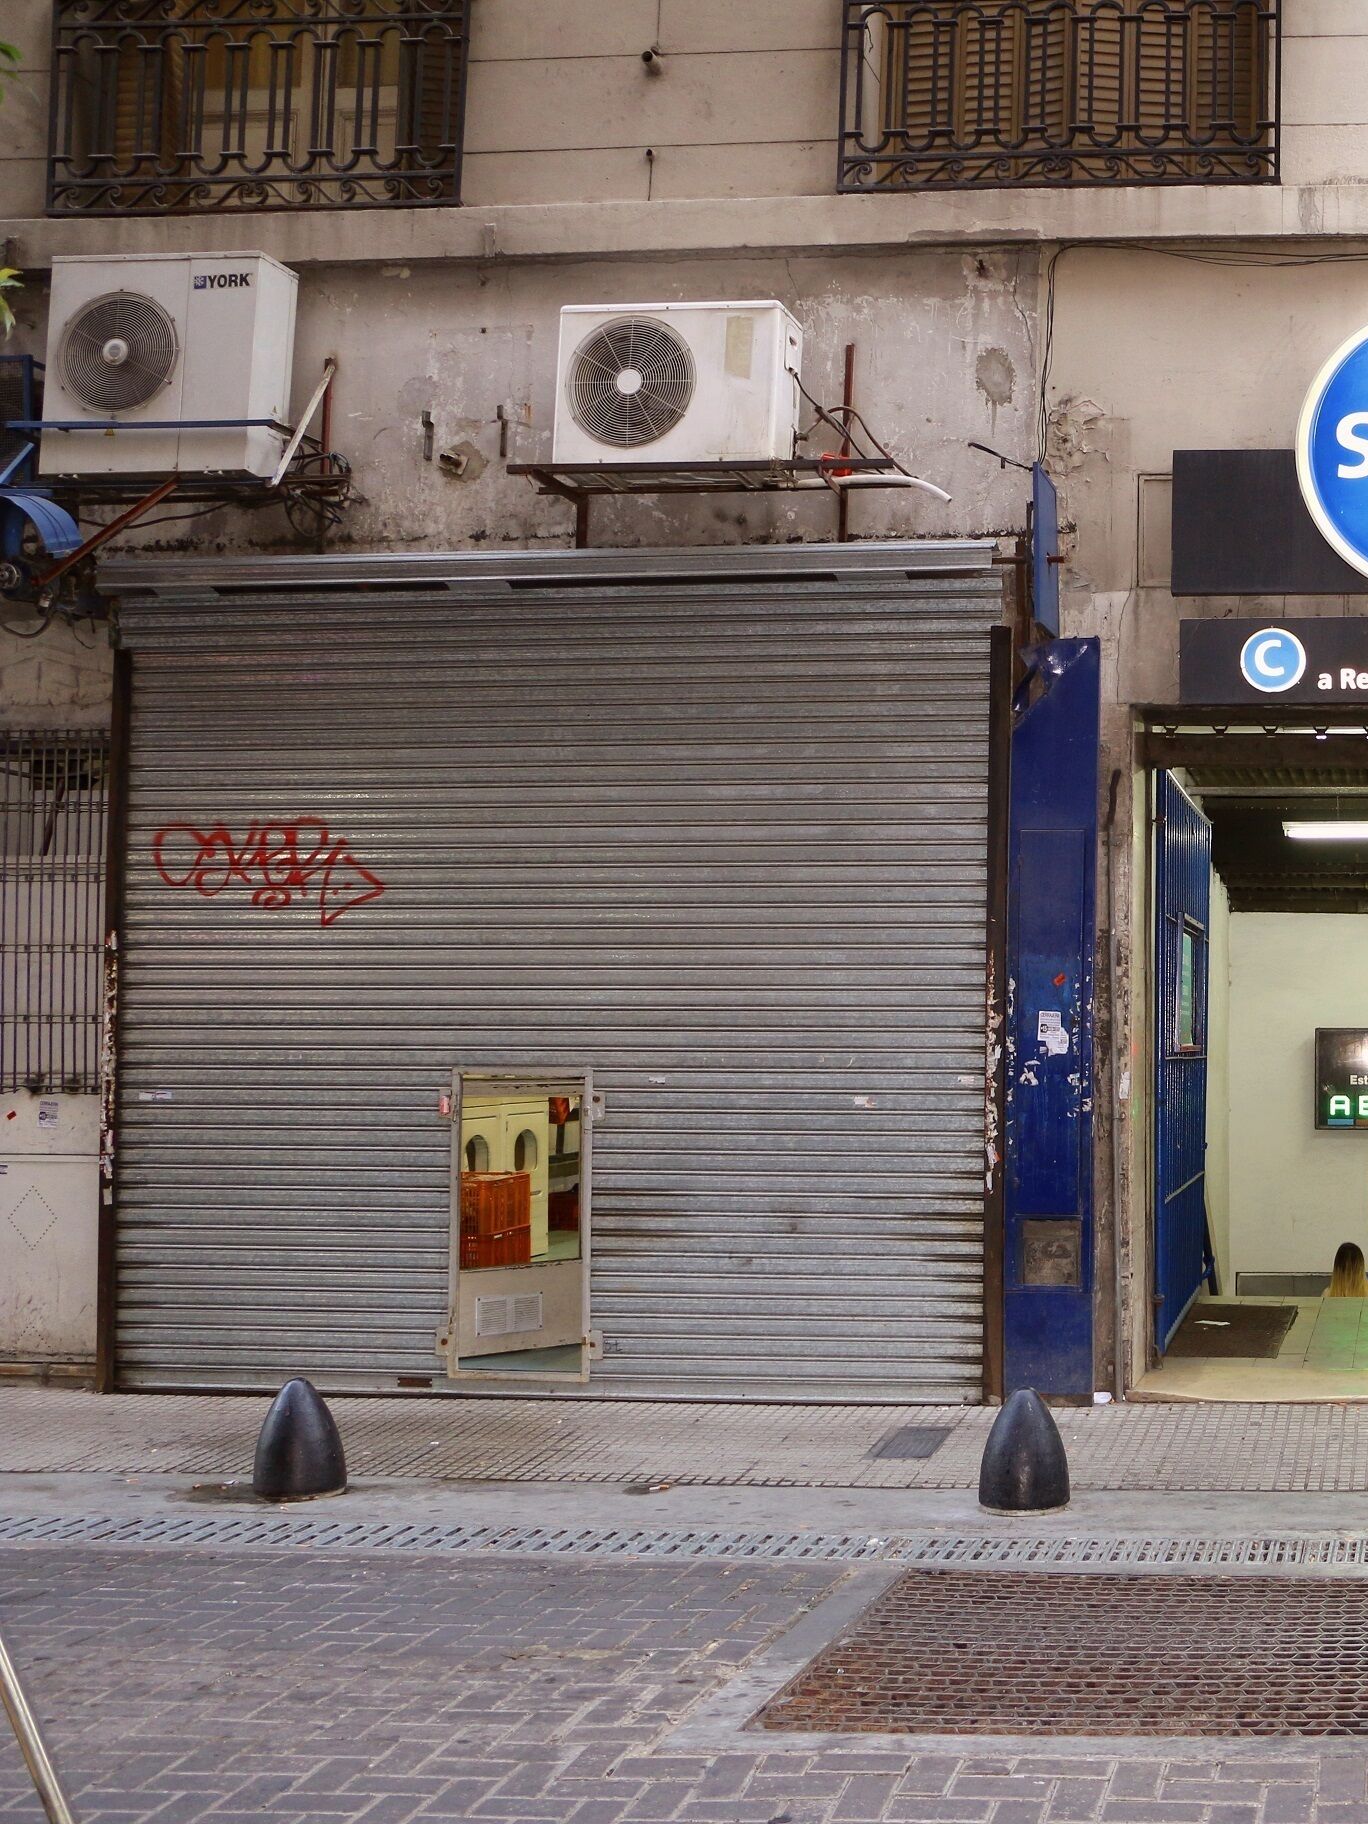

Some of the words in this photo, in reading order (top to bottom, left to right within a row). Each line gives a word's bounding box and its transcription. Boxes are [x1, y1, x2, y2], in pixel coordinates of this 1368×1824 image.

[208, 273, 250, 288] YORK
[1254, 640, 1285, 677] C
[1317, 672, 1333, 690] a
